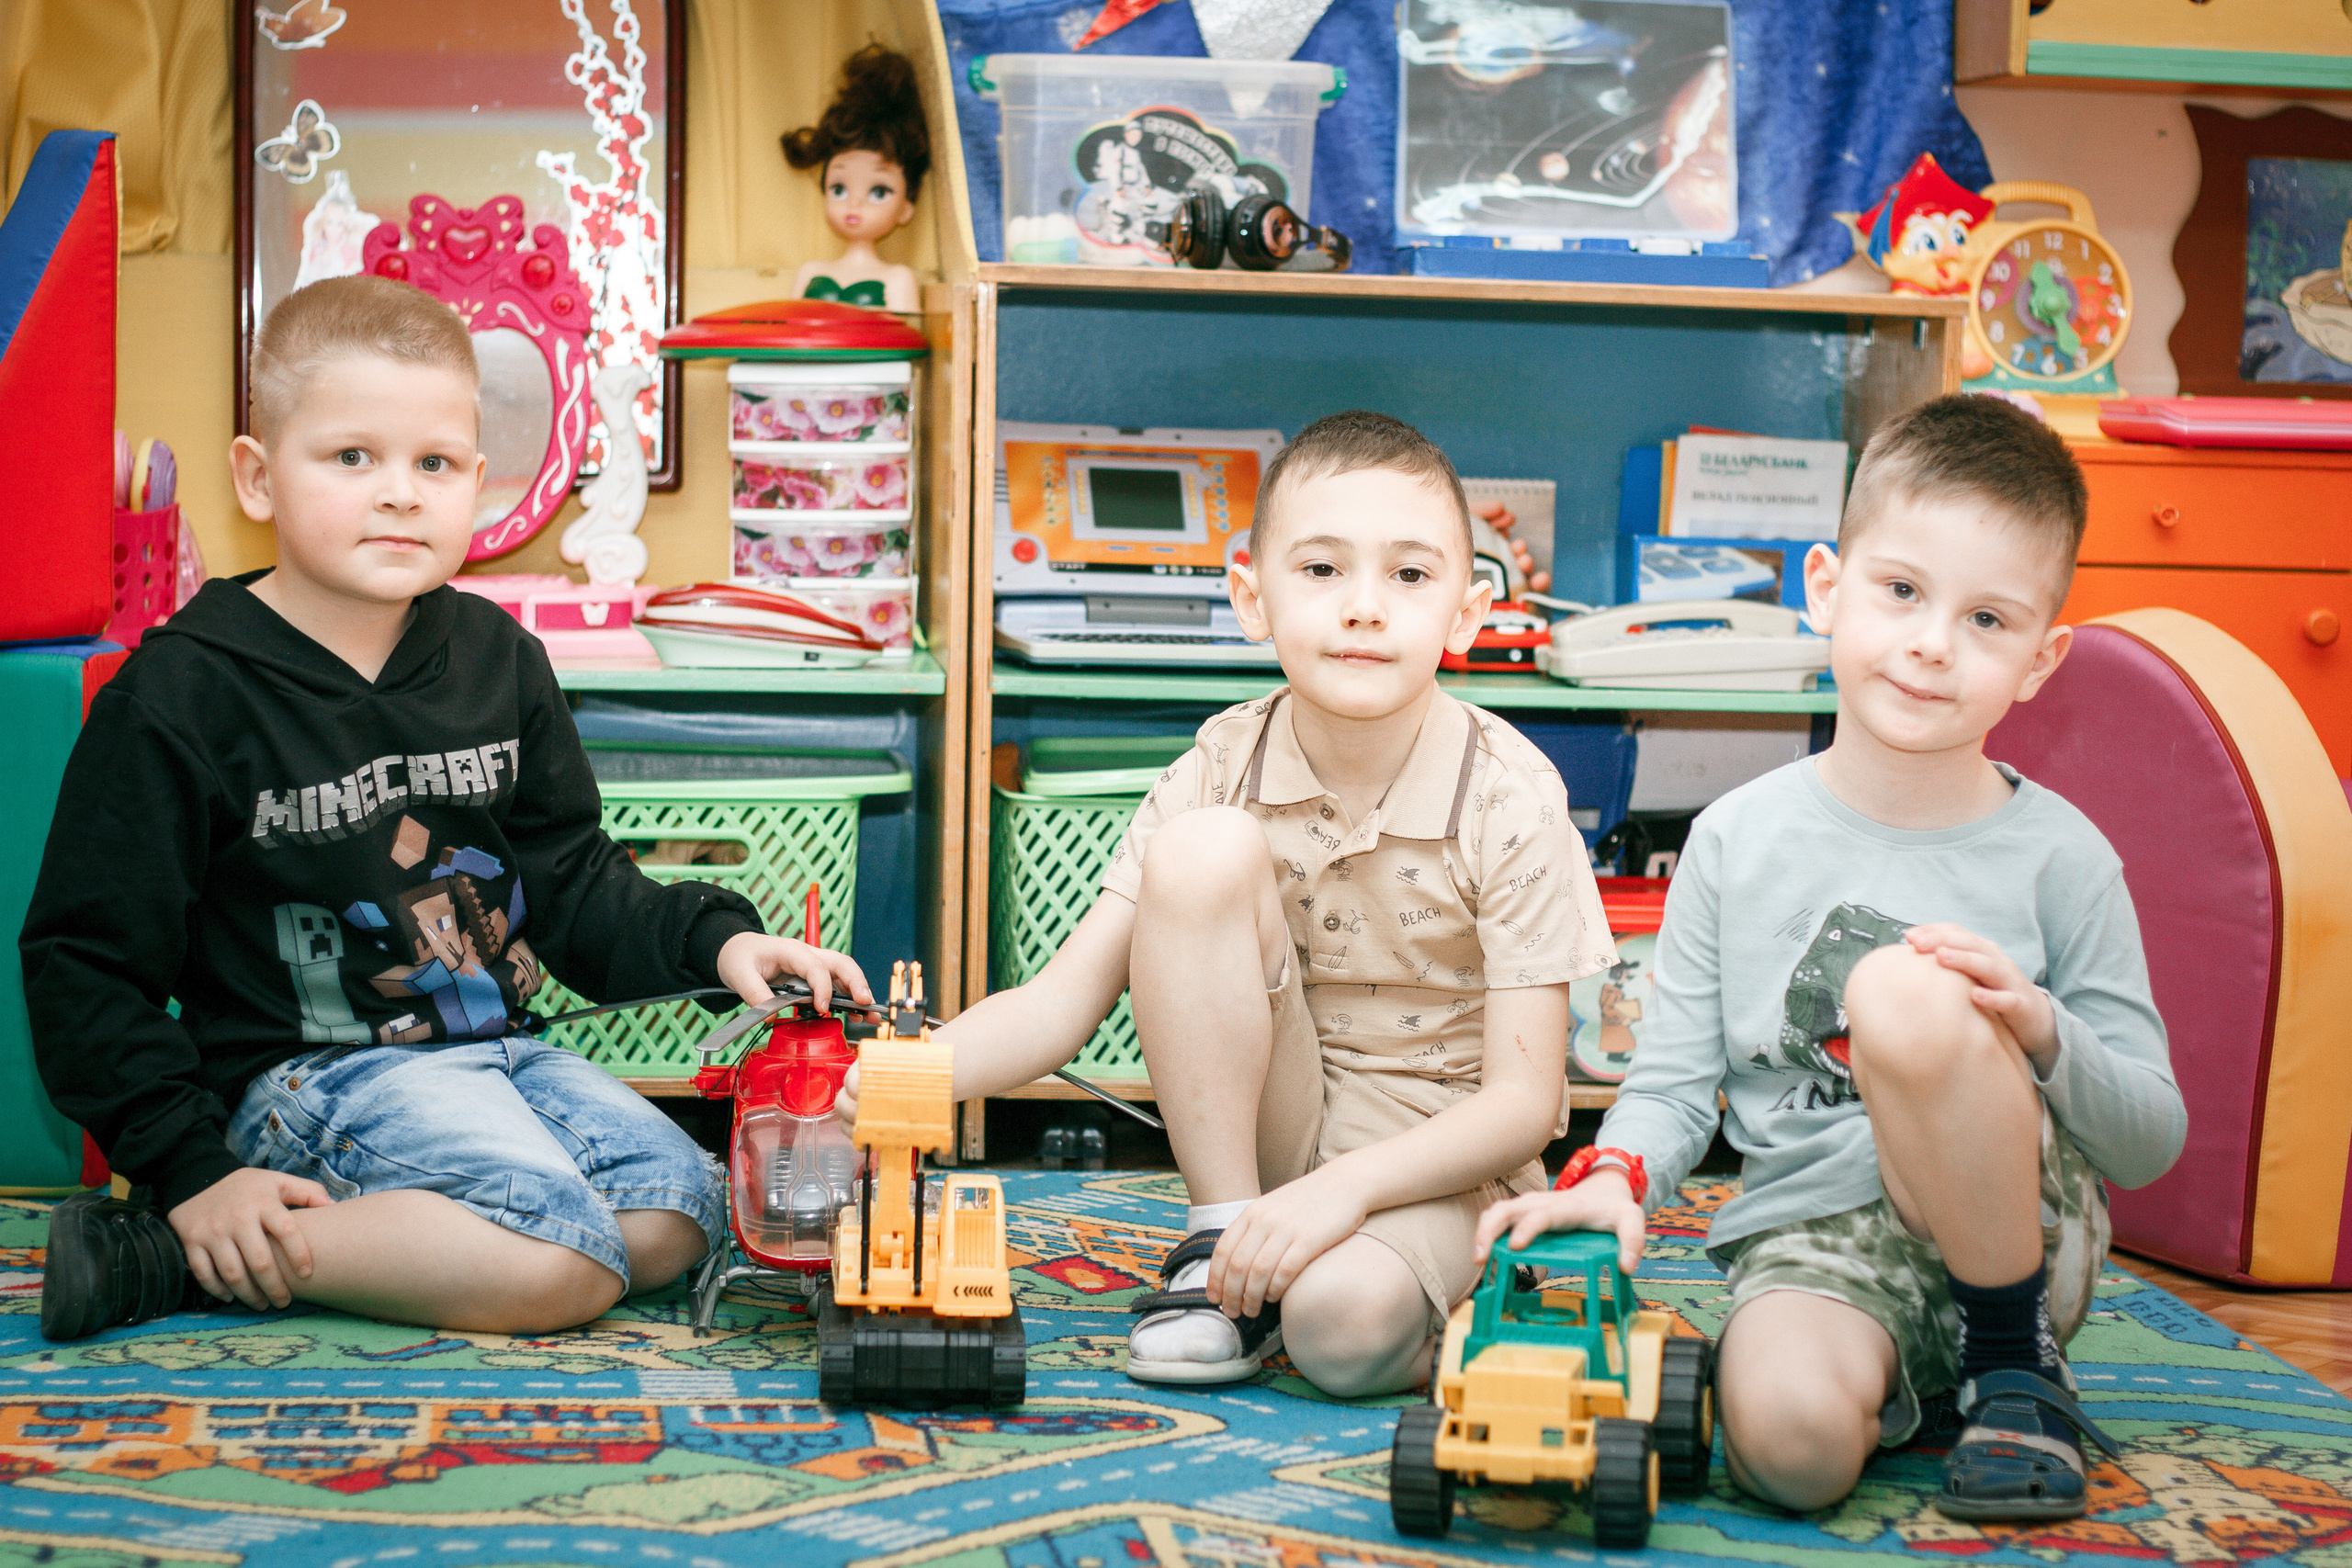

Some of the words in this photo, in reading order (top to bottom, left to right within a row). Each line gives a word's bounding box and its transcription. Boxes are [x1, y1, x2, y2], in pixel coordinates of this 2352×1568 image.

[2013, 239, 2030, 259] 11
[2043, 231, 2064, 251] 12
[2079, 239, 2089, 261] 1
[1990, 260, 2011, 282] 10
[2098, 263, 2112, 285] 2
[1982, 288, 1996, 311] 9
[2106, 294, 2123, 316] 3
[1989, 321, 2005, 344] 8
[2096, 324, 2111, 346] 4
[2011, 343, 2025, 366] 7
[2075, 347, 2088, 369] 5
[2041, 355, 2057, 377] 6
[252, 739, 520, 847] MINECRAFT
[1509, 866, 1548, 893] BEACH
[1398, 907, 1442, 927] BEACH
